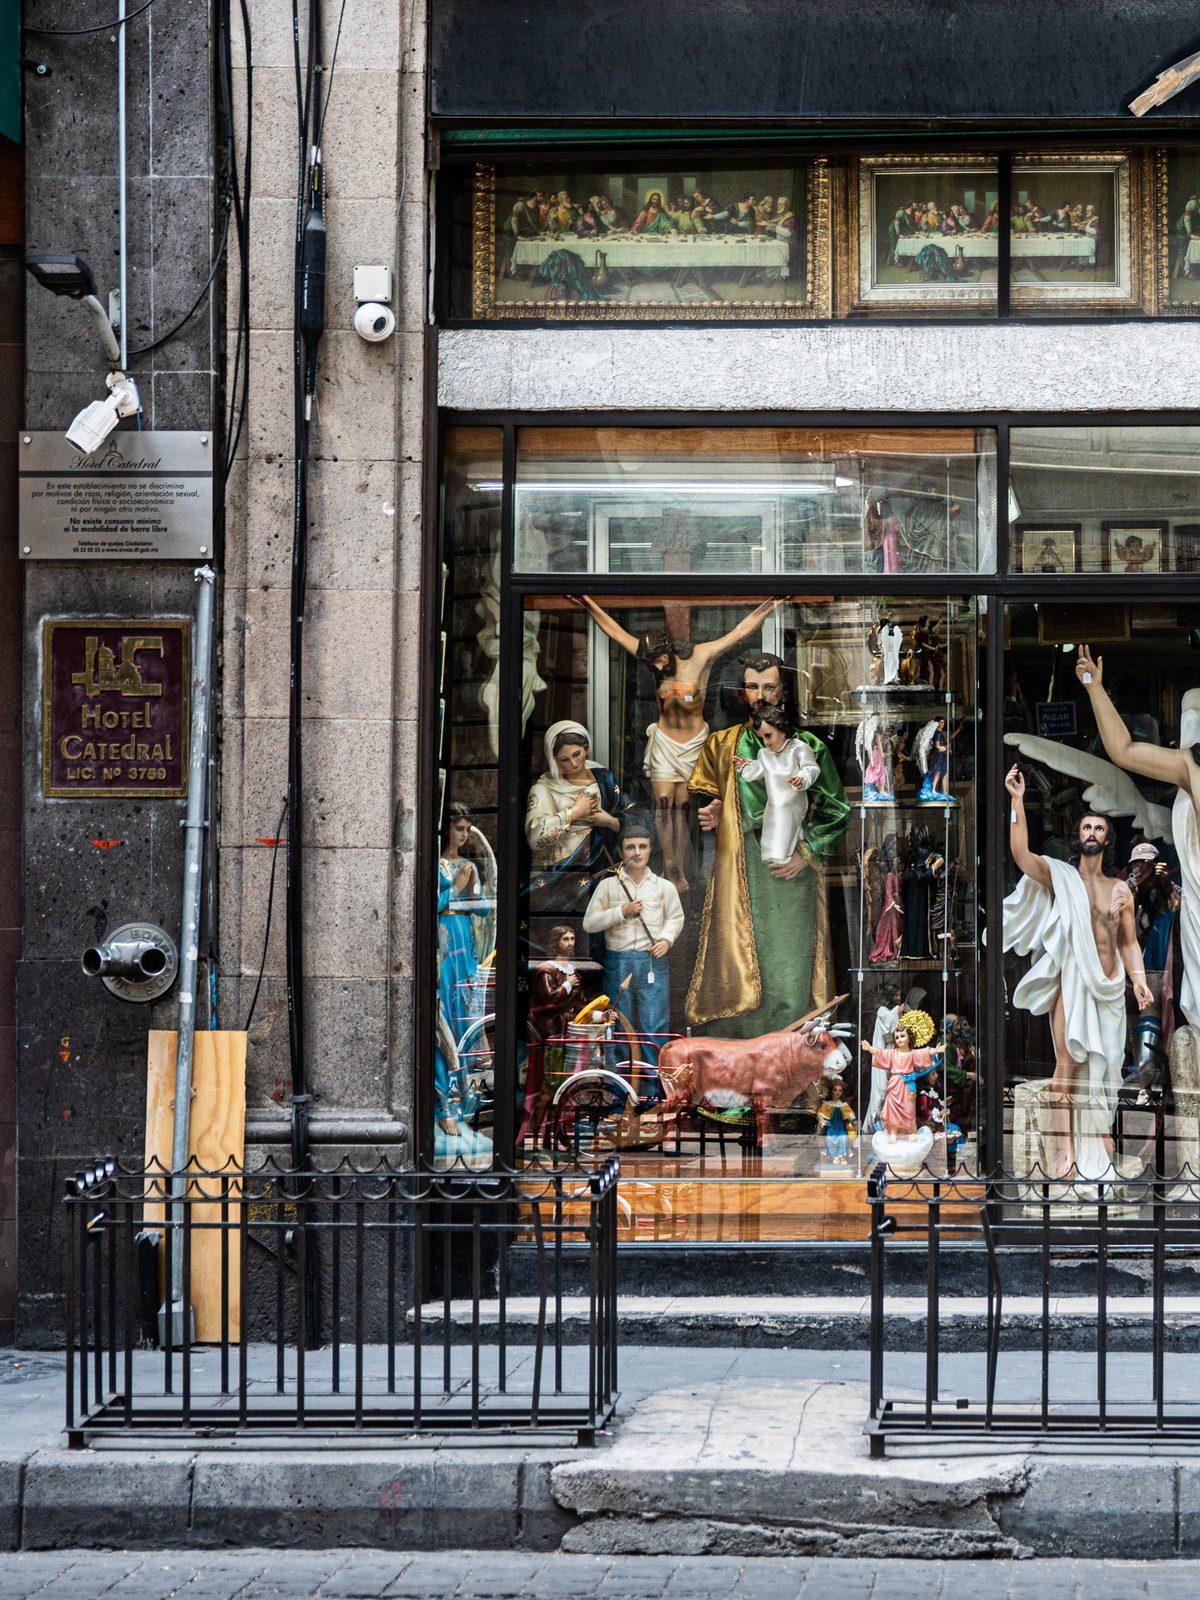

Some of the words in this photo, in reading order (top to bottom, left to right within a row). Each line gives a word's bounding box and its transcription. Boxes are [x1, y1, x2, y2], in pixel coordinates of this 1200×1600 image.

[69, 455, 104, 470] Hotel
[108, 456, 162, 470] Catedral
[46, 482, 56, 490] En
[58, 482, 71, 490] este
[73, 482, 126, 490] establecimiento
[148, 482, 184, 490] discrimina
[31, 491, 44, 499] por
[84, 491, 103, 499] raza,
[104, 490, 133, 499] religión,
[175, 490, 200, 498] sexual,
[93, 506, 117, 514] ningún
[70, 517, 81, 525] No
[82, 517, 103, 525] existe
[63, 525, 70, 533] ni
[72, 525, 79, 533] la
[80, 525, 118, 533] modalidad
[119, 525, 129, 533] de
[130, 525, 150, 533] barra
[152, 525, 168, 533] libre
